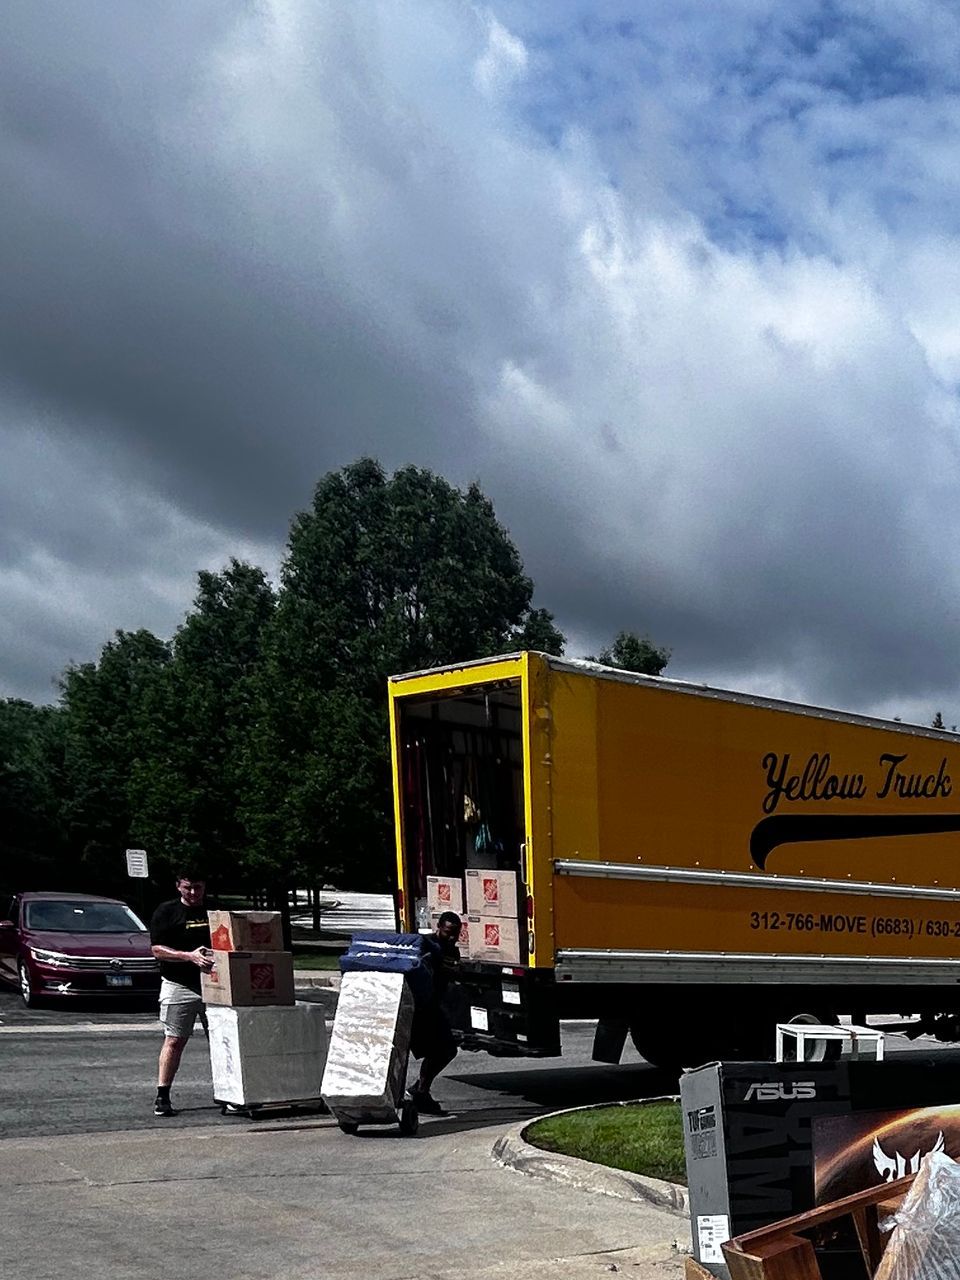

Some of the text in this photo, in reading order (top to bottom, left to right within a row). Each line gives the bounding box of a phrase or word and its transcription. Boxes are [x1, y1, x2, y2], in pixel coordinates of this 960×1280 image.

[762, 752, 867, 814] Yellow
[876, 753, 952, 798] Truck
[750, 911, 867, 933] 312-766-MOVE
[871, 916, 915, 939] (6683)
[918, 920, 923, 935] /
[744, 1081, 816, 1100] ASUS
